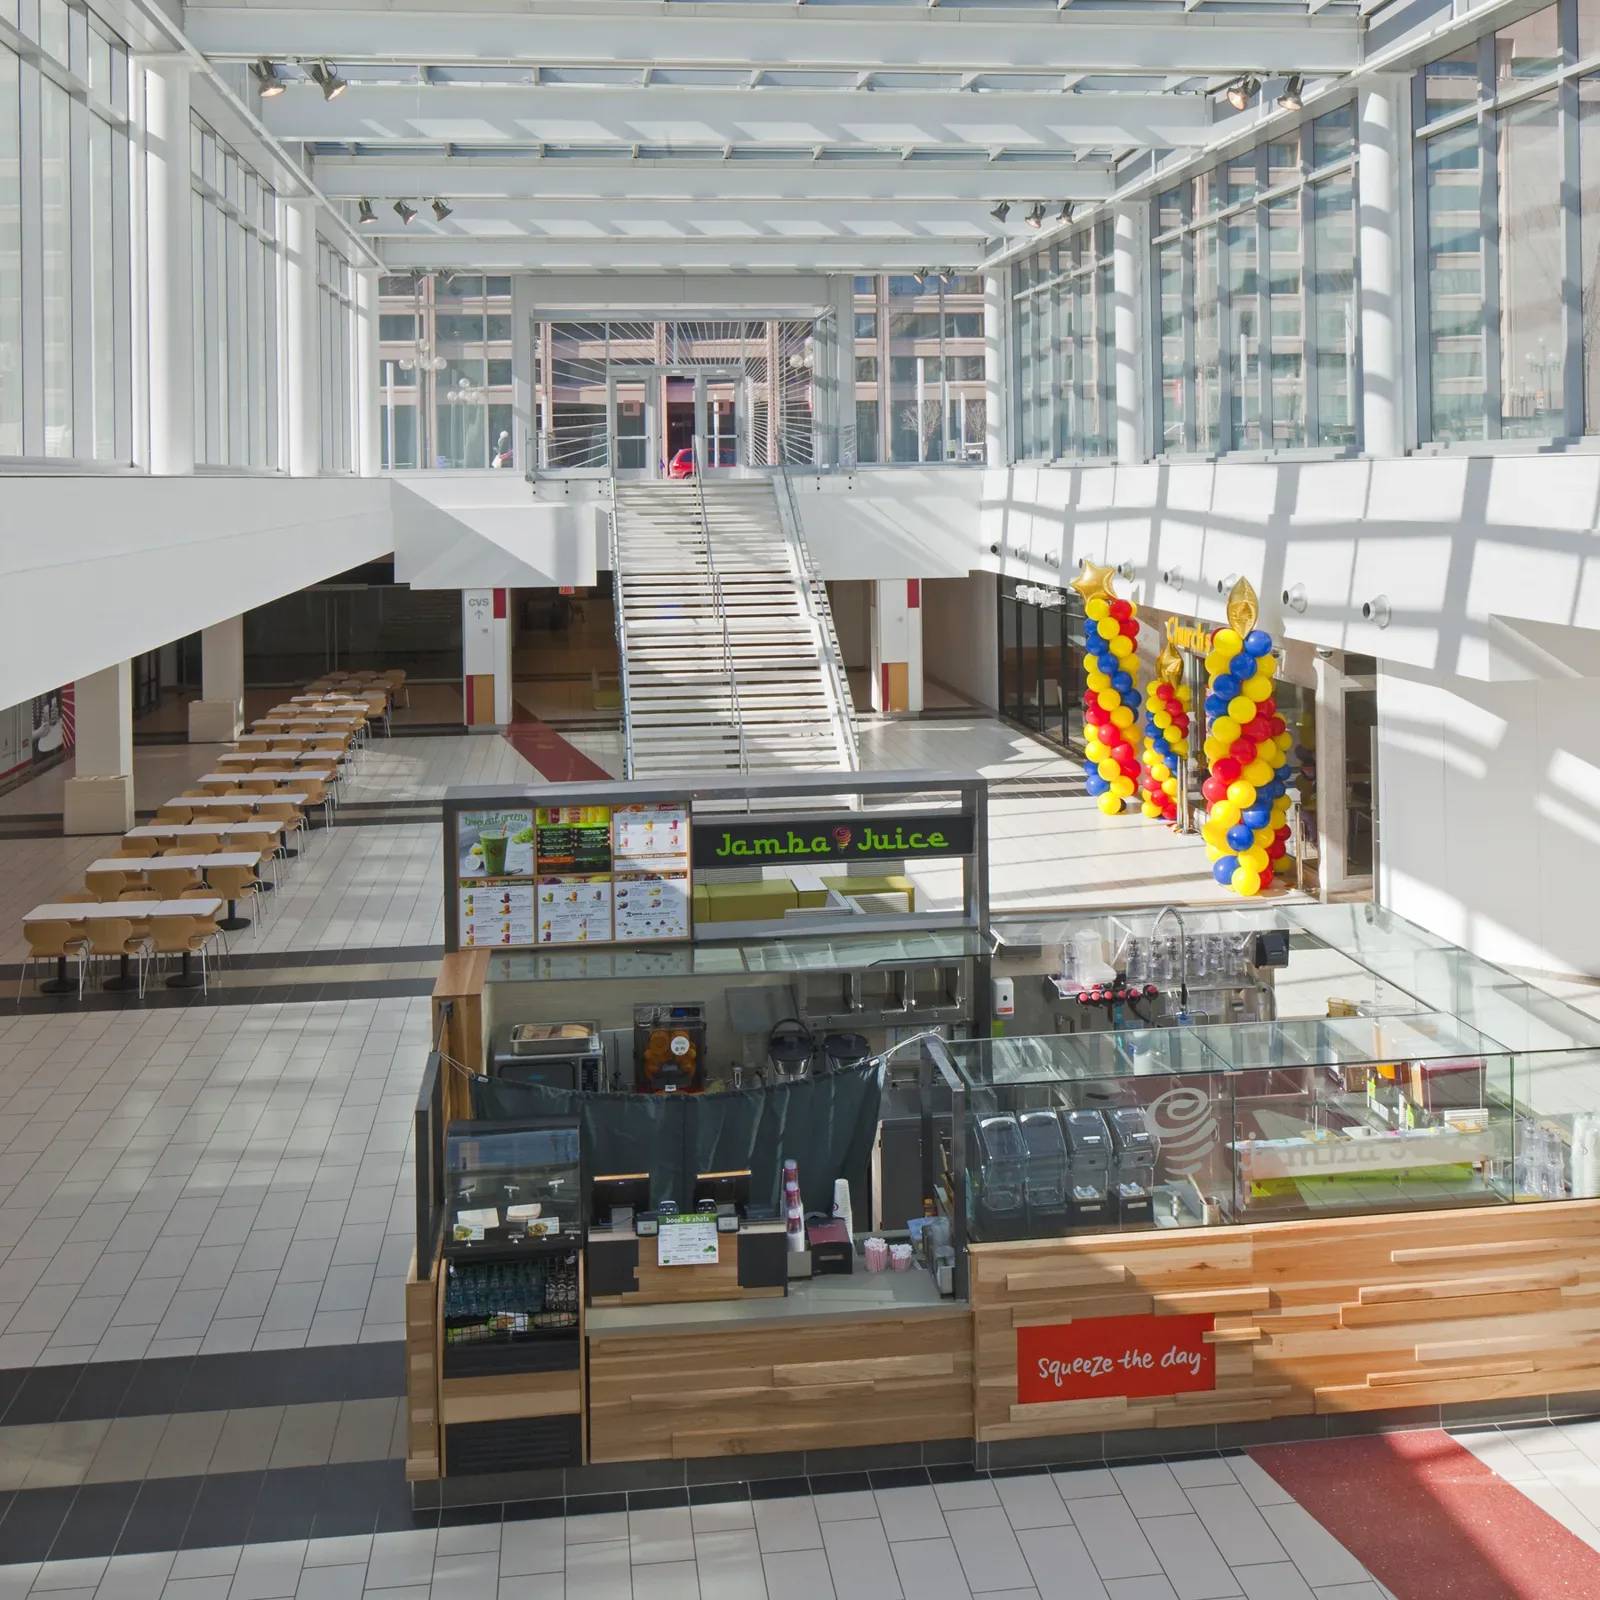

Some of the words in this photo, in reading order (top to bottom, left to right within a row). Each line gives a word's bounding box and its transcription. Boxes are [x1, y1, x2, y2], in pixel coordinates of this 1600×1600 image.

[468, 597, 490, 607] CVS
[501, 813, 528, 825] greens
[716, 831, 832, 857] Jamba
[857, 827, 949, 851] Juice
[665, 1216, 684, 1224] boost
[1117, 1349, 1155, 1370] the
[1160, 1345, 1201, 1375] day
